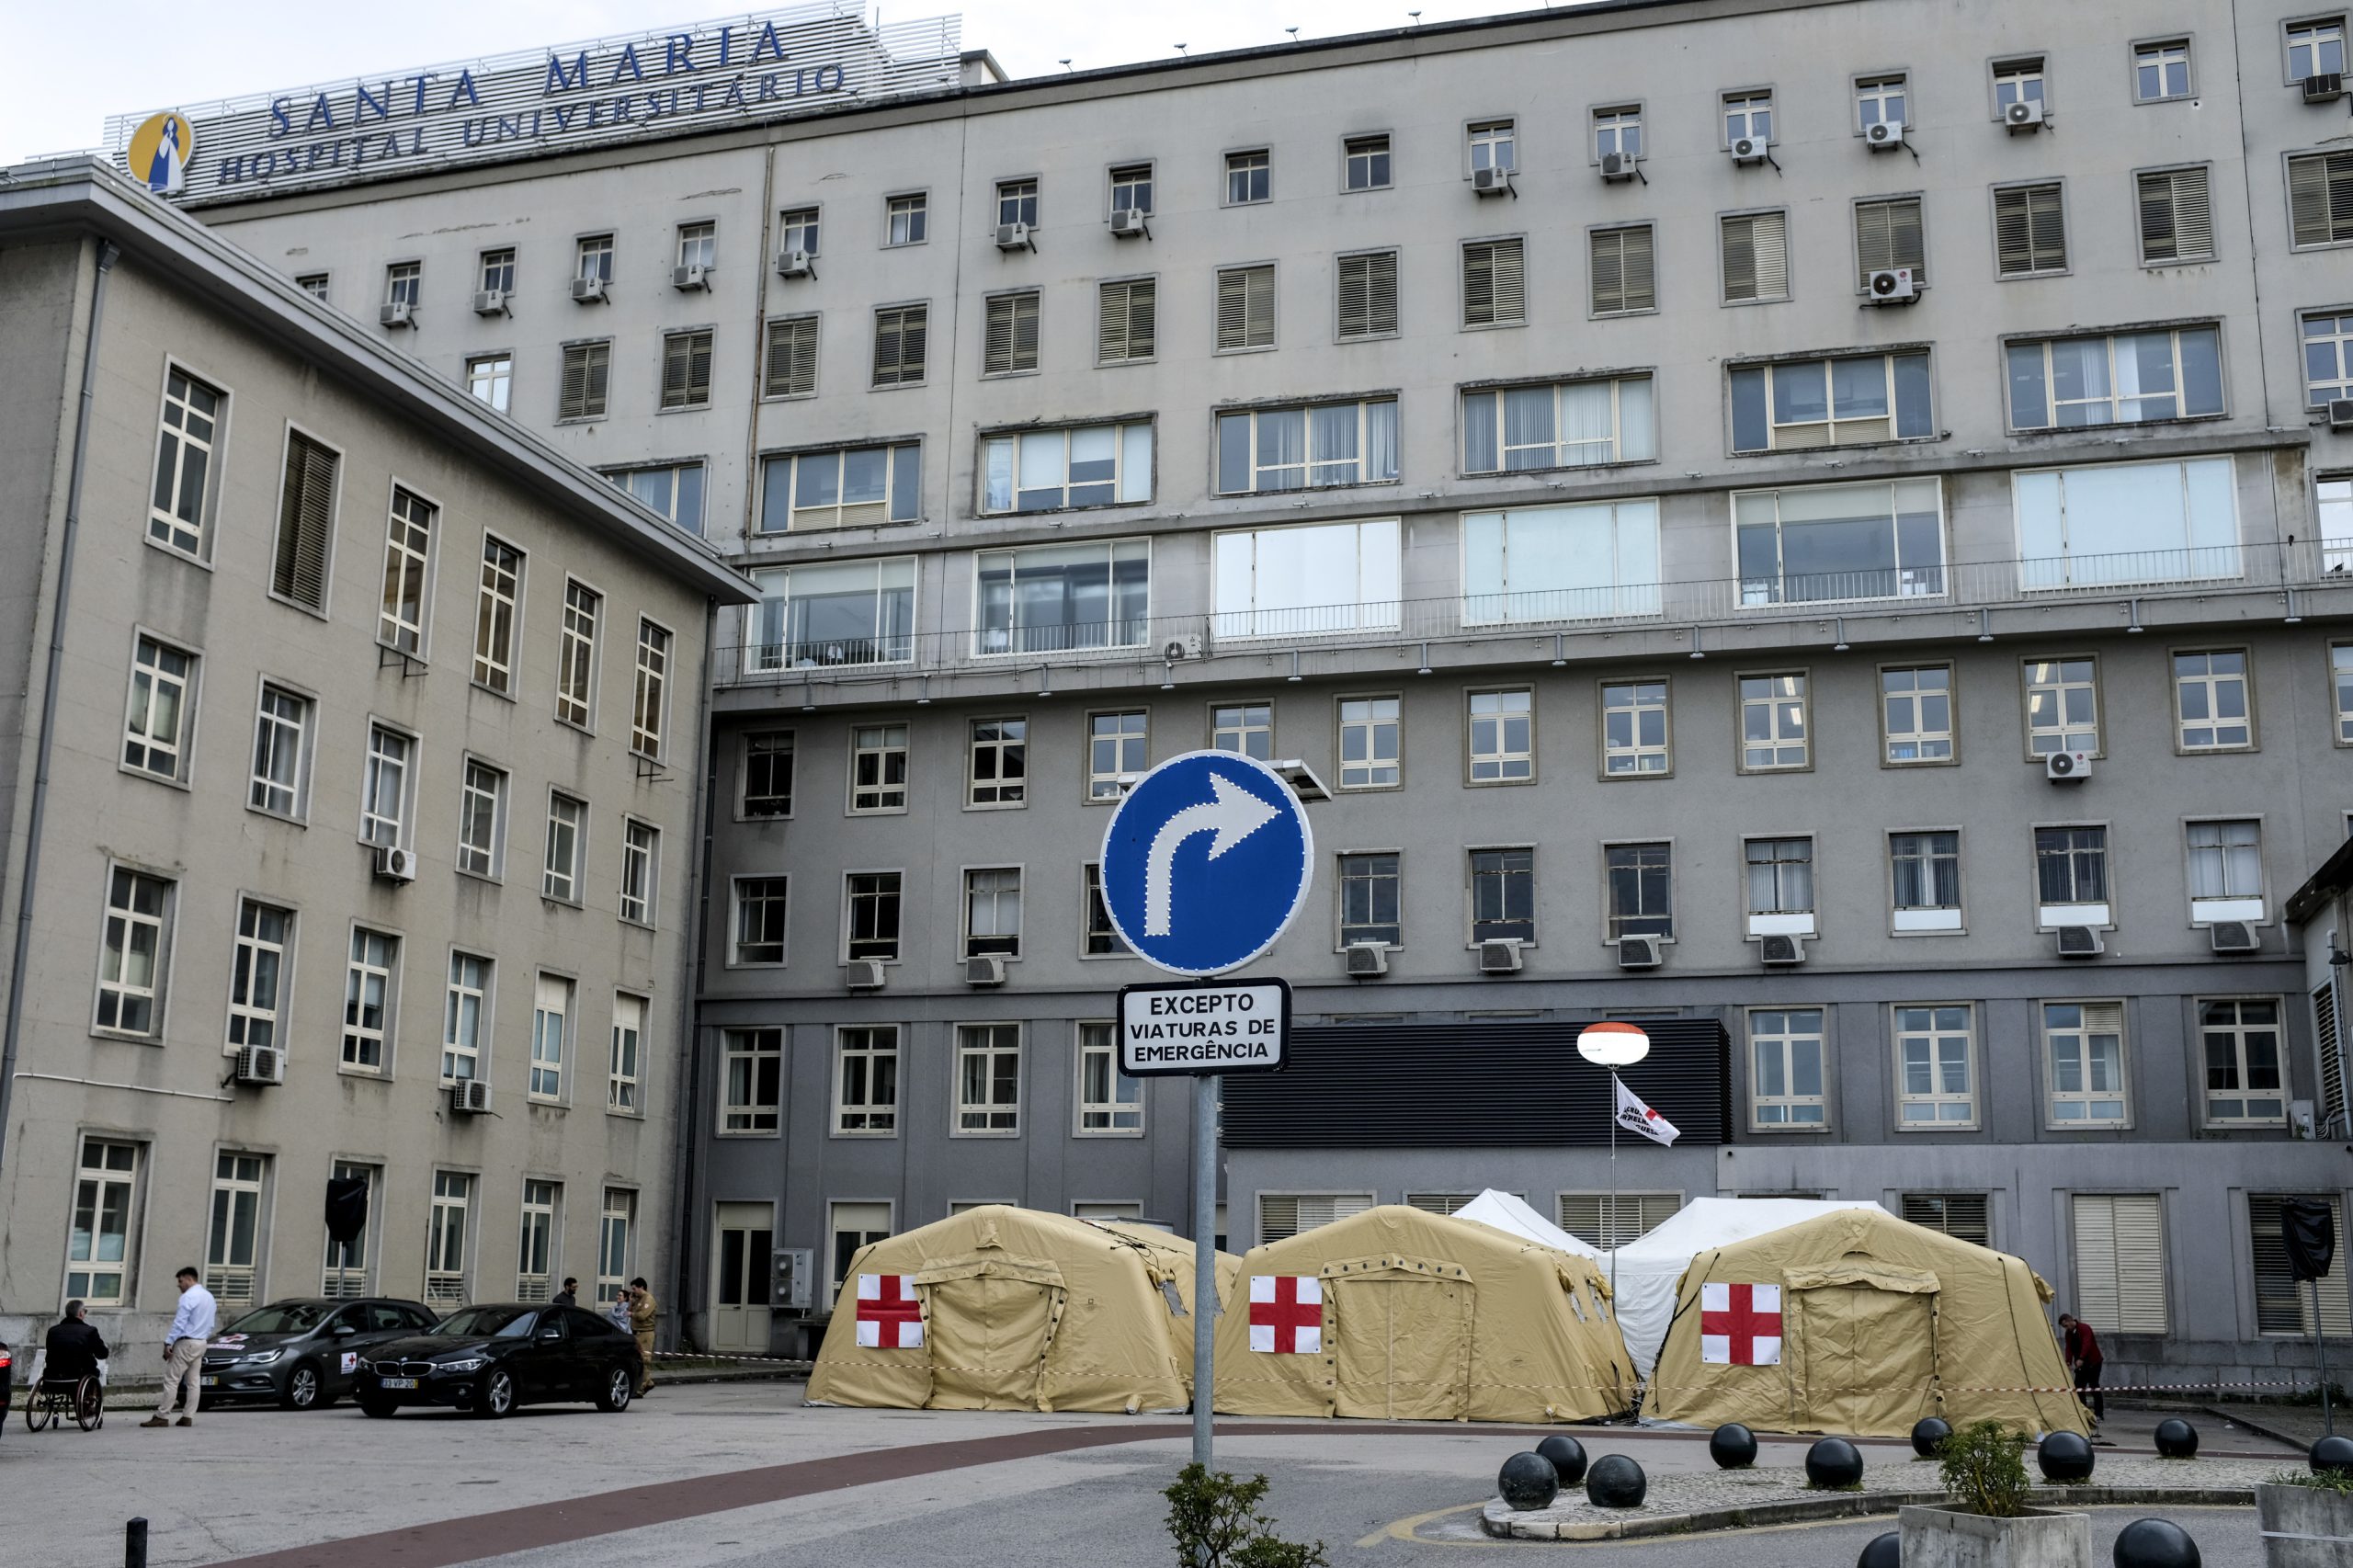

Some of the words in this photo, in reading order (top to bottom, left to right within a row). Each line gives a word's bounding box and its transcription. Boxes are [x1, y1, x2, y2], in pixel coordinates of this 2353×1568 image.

[267, 68, 483, 139] SANTA
[542, 20, 789, 95] MARIA
[217, 127, 428, 185] HOSPITAL
[461, 63, 846, 147] UNIVERSITÁRIO
[1150, 993, 1254, 1016] EXCEPTO
[1130, 1020, 1238, 1040] VIATURAS
[1248, 1018, 1275, 1035] DE
[1134, 1040, 1268, 1062] EMERGÊNCIA
